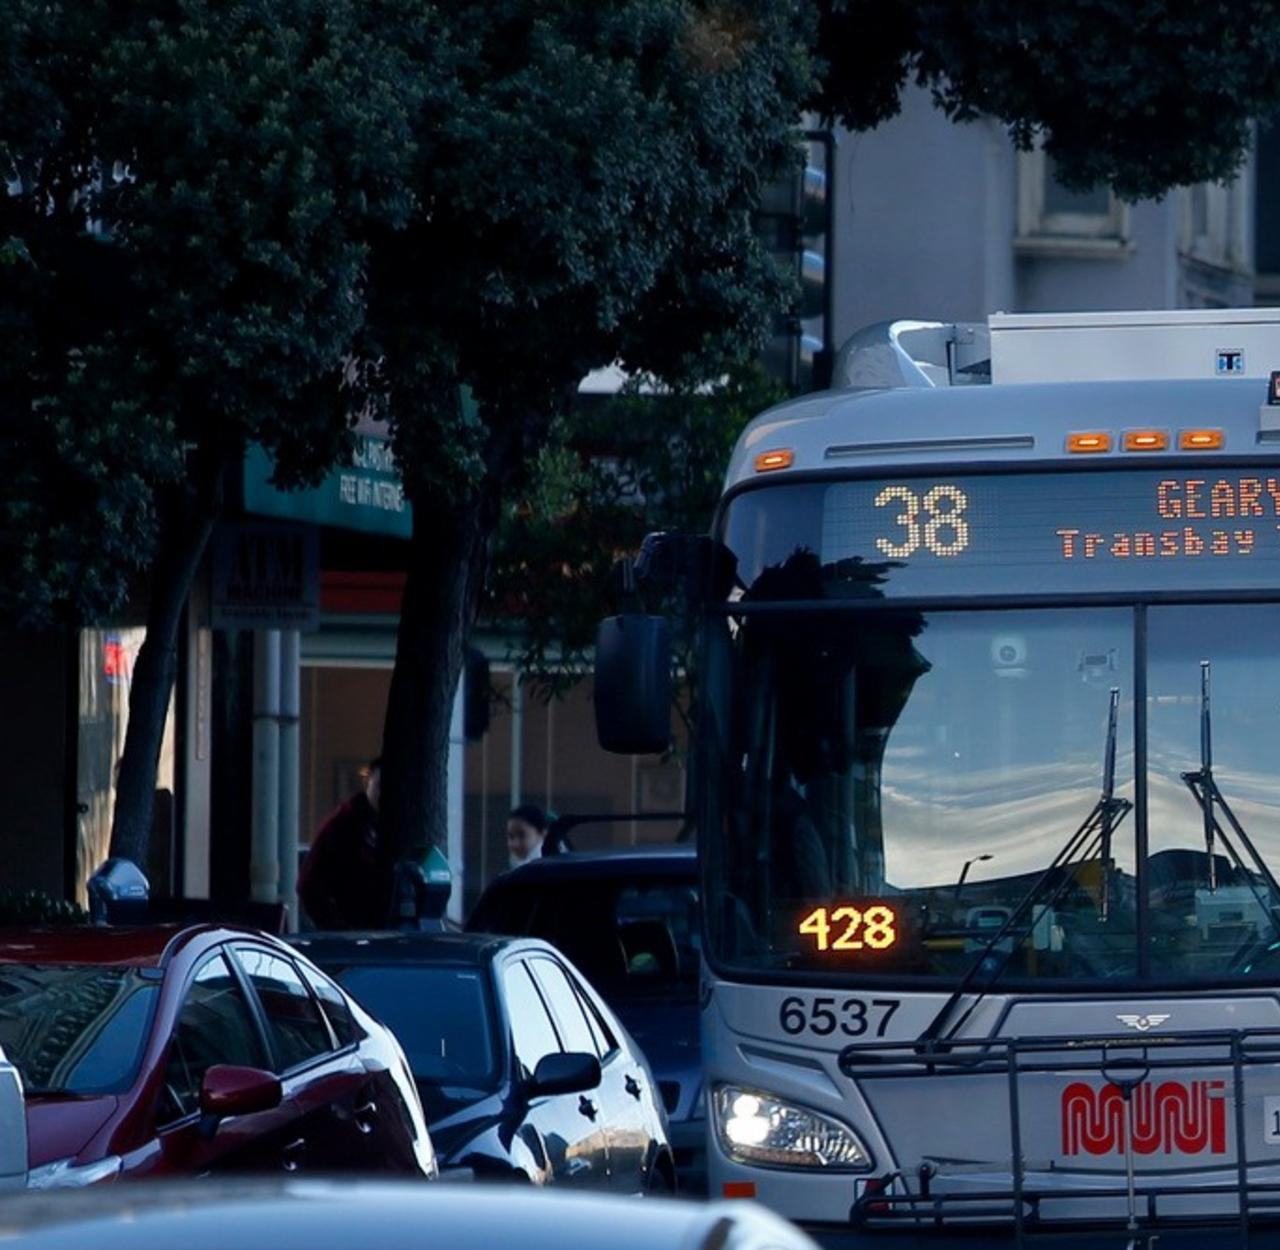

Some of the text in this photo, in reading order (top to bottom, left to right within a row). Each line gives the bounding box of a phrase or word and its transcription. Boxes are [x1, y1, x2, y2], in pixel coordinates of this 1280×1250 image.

[873, 484, 970, 558] 38
[1055, 527, 1254, 558] Transbay
[799, 905, 896, 951] 428
[779, 996, 901, 1037] 6537
